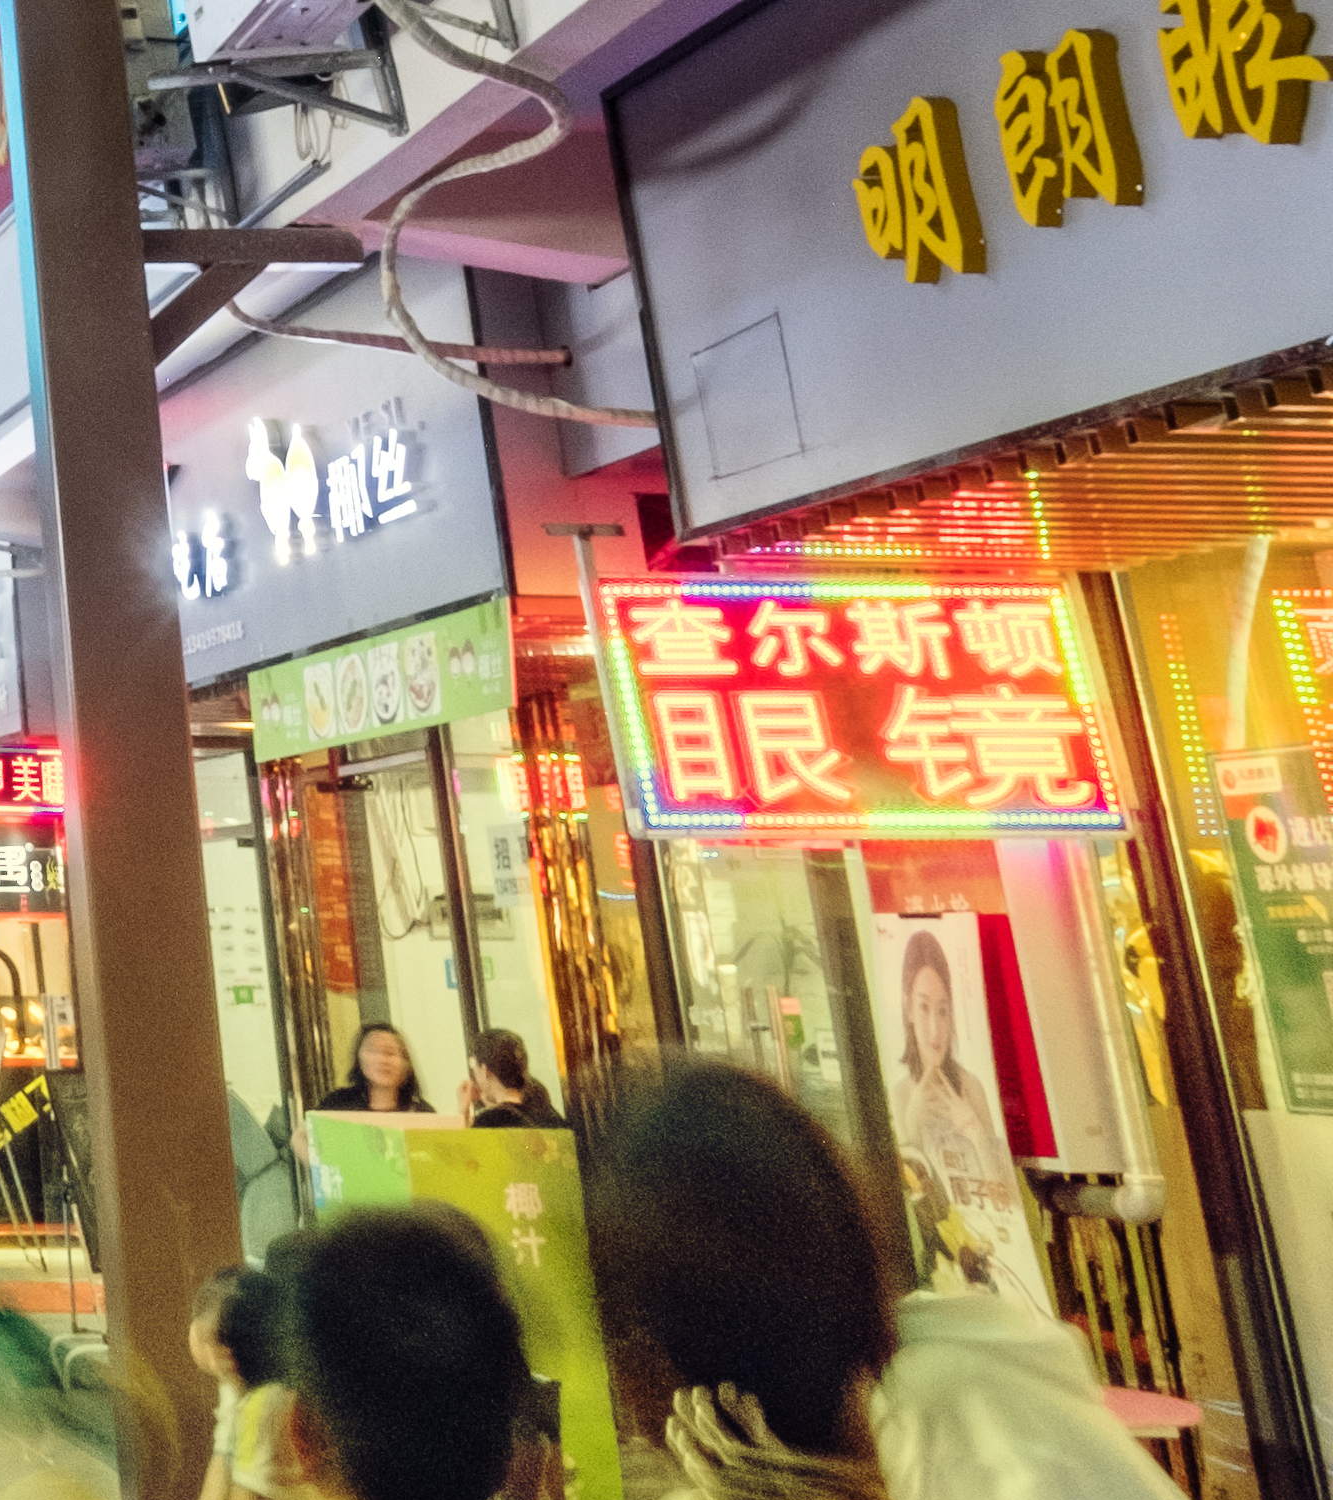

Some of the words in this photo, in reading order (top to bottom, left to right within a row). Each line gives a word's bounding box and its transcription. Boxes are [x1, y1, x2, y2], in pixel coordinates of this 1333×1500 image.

[326, 427, 417, 544] 椰丝
[628, 599, 1066, 681] 查尔斯顿
[650, 685, 1098, 808] 眼镜
